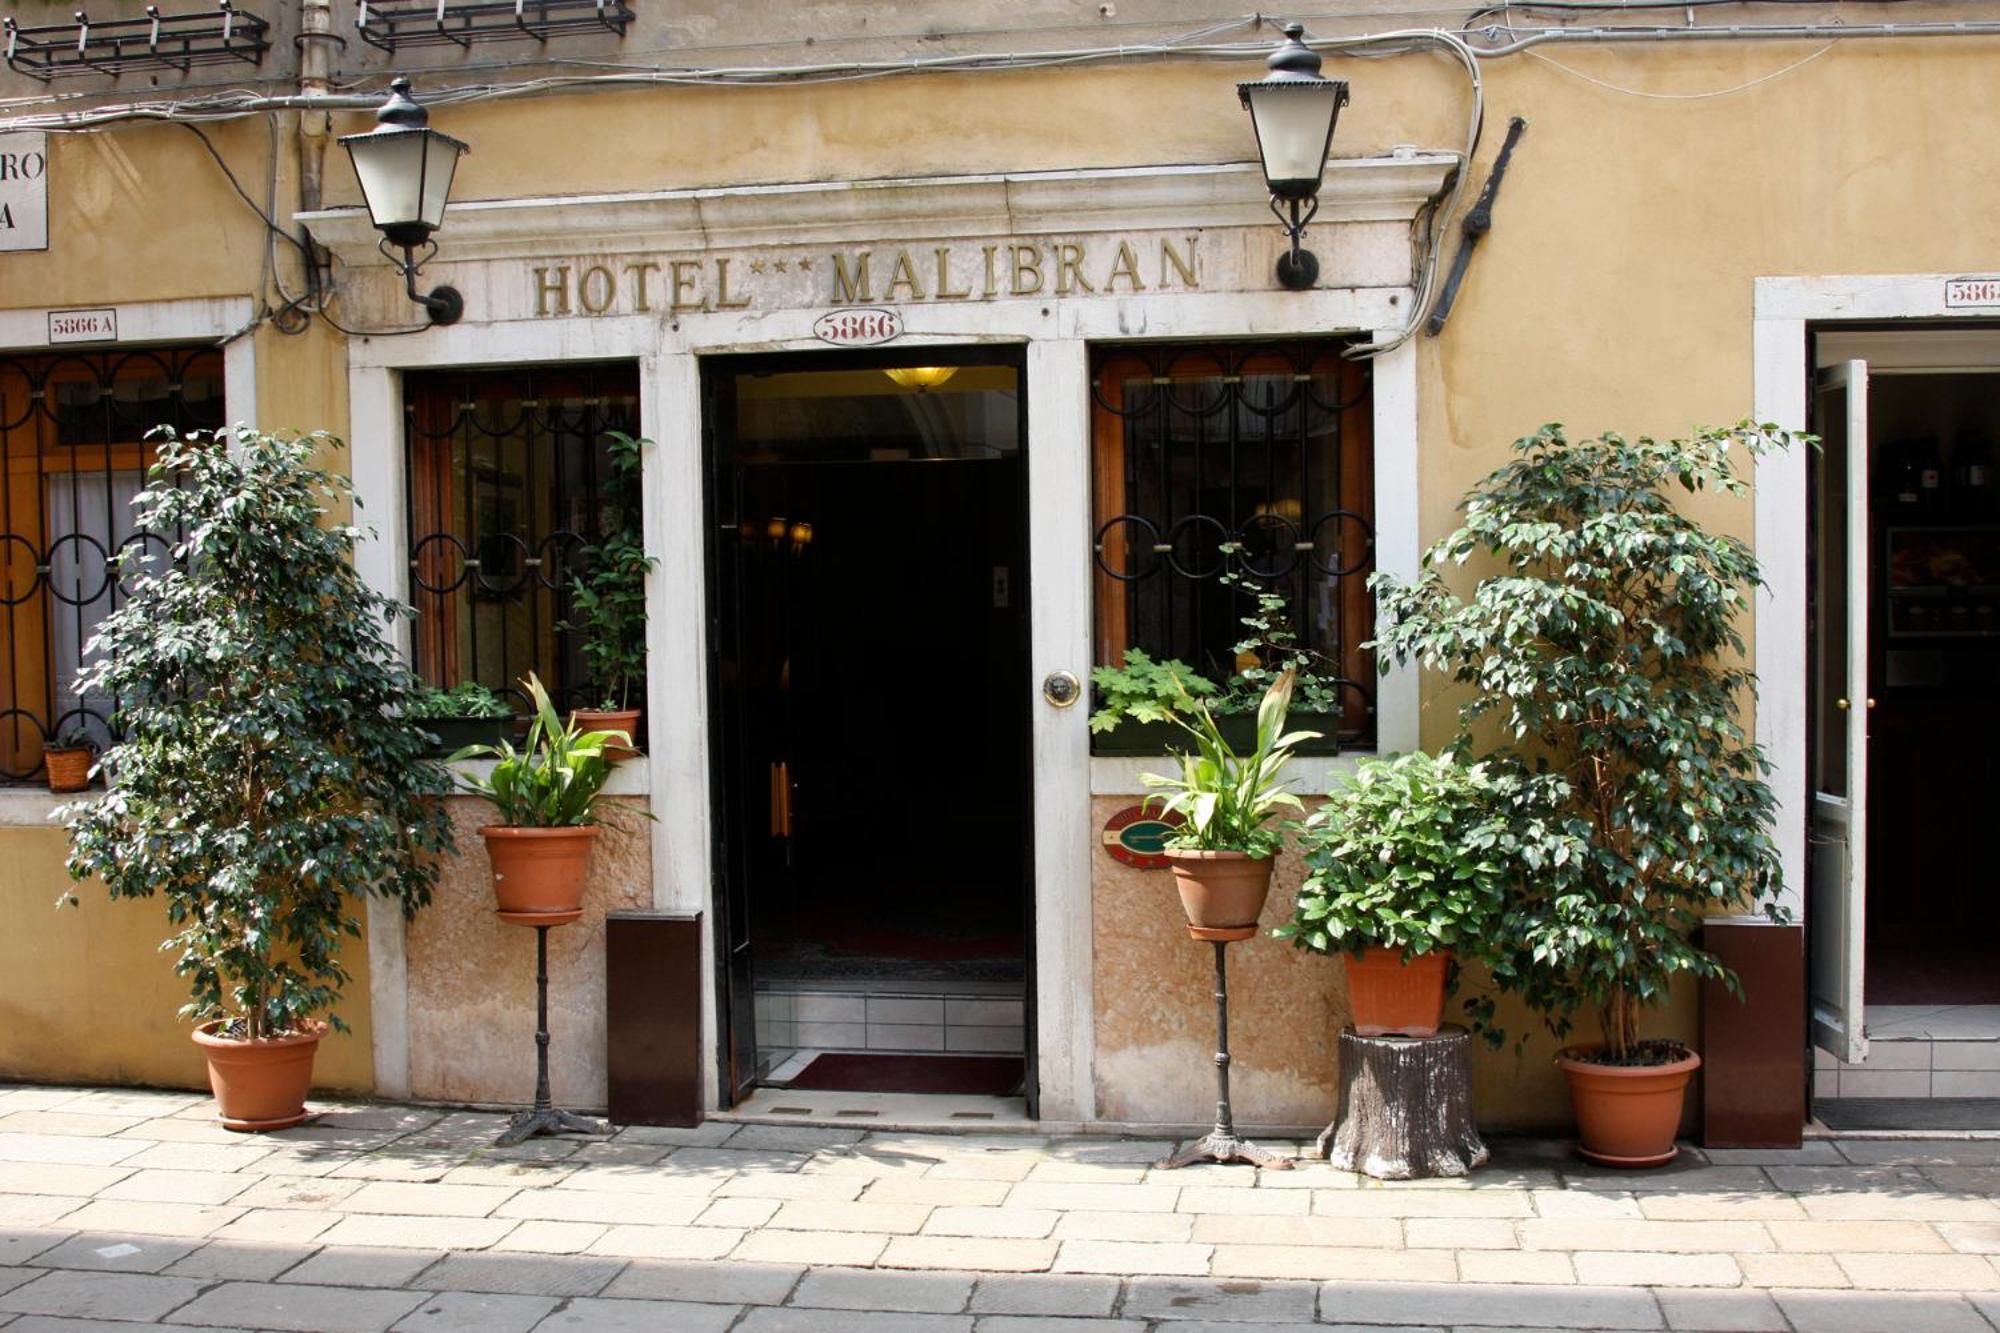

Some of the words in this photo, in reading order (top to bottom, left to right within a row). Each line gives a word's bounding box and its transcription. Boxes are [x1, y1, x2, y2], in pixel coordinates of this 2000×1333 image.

[533, 257, 752, 317] HOTEL
[831, 235, 1200, 303] MALIBRAN
[1952, 283, 2000, 301] 586
[53, 317, 98, 334] 5866
[102, 316, 112, 332] A
[822, 315, 895, 339] 5866
